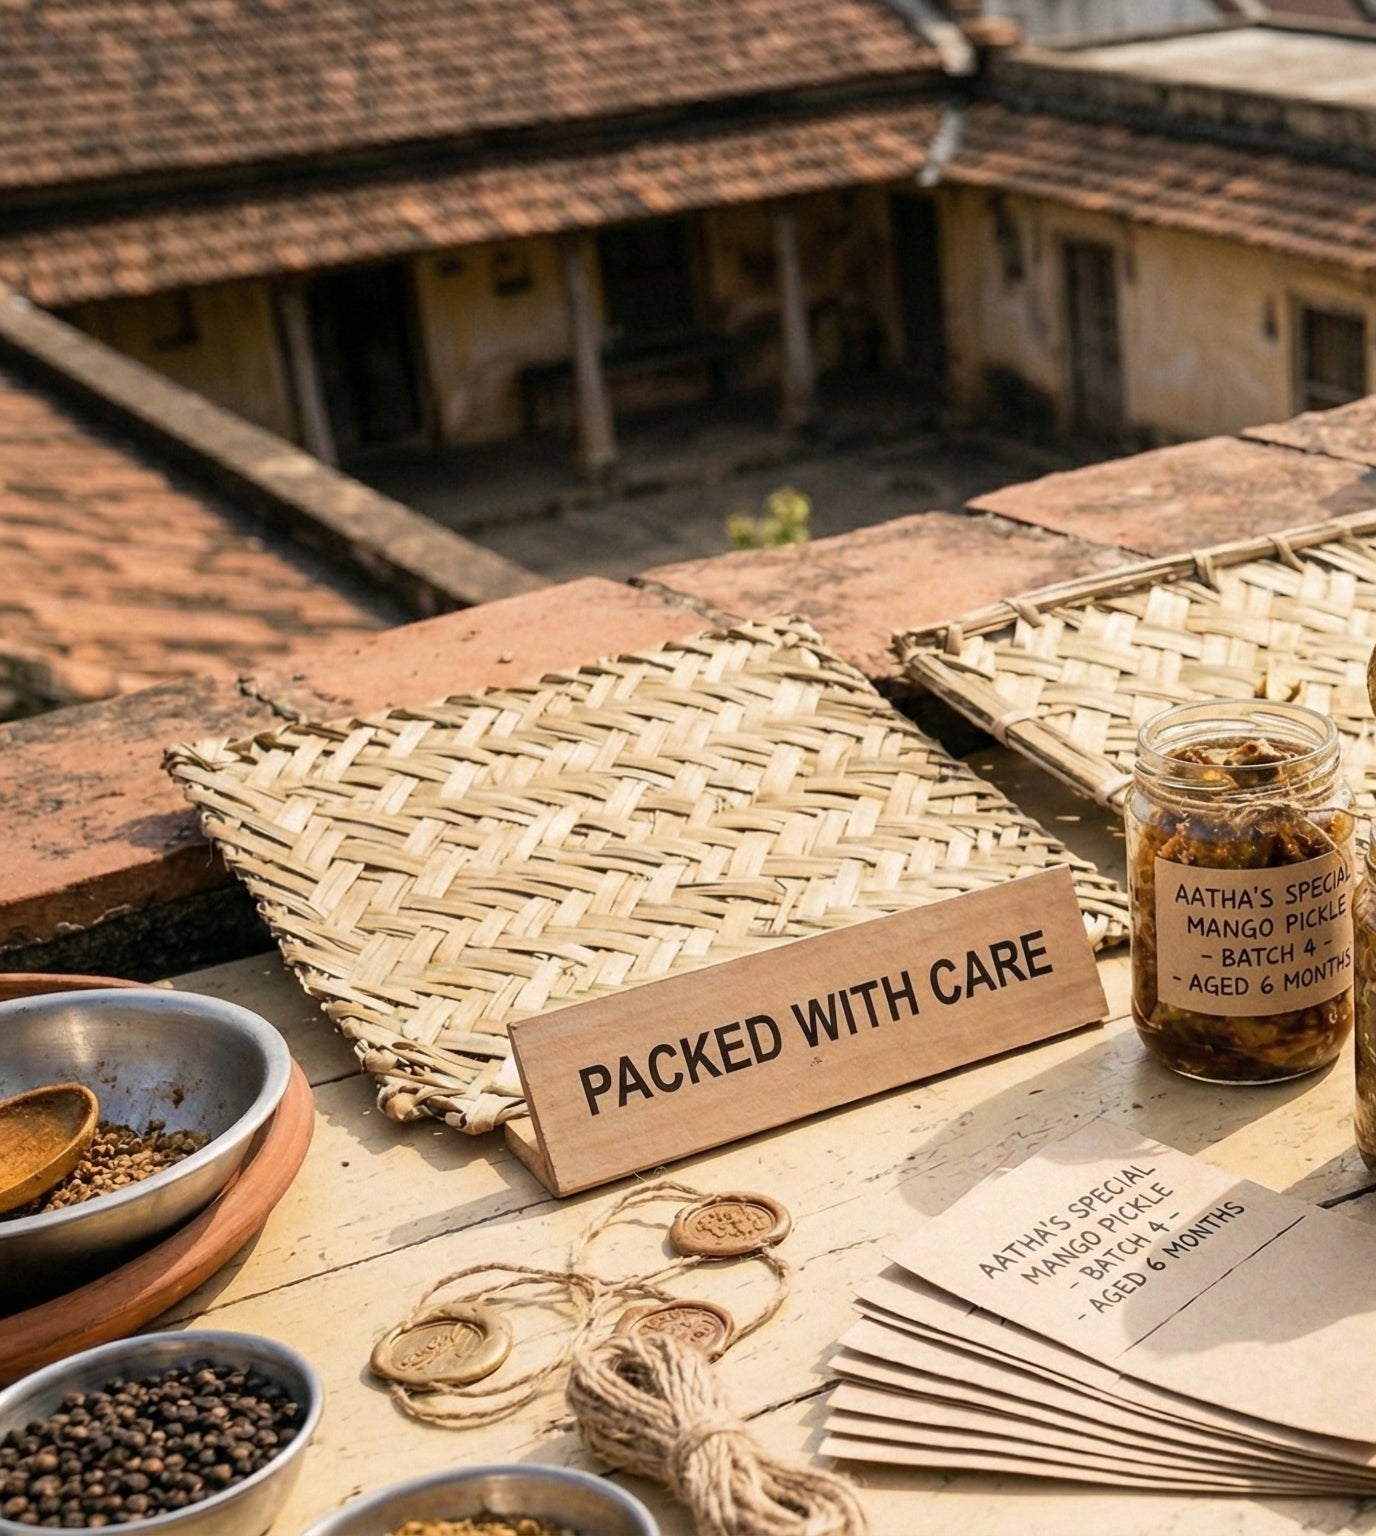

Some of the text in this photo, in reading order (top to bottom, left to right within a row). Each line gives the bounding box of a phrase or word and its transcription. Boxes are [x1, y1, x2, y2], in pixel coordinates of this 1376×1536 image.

[1175, 866, 1351, 910] AATHA'S SPECIAL
[1187, 893, 1346, 940] MANGO PICKLE
[1189, 973, 1249, 997] AGED
[1260, 975, 1274, 994] 6
[1284, 947, 1351, 992] MONTHS
[1222, 943, 1294, 968] BATCH
[1304, 938, 1316, 957] 4
[578, 929, 1054, 1117] PACKED WITH CARE
[978, 1165, 1156, 1280] AATHA'S SPECIAL
[1021, 1182, 1174, 1285] MANGO PICKLE
[1080, 1233, 1151, 1280] BATCH
[1148, 1220, 1170, 1233] 4
[1089, 1272, 1147, 1314] AGED
[1146, 1257, 1166, 1271] 6
[1162, 1201, 1245, 1259] MONTHS
